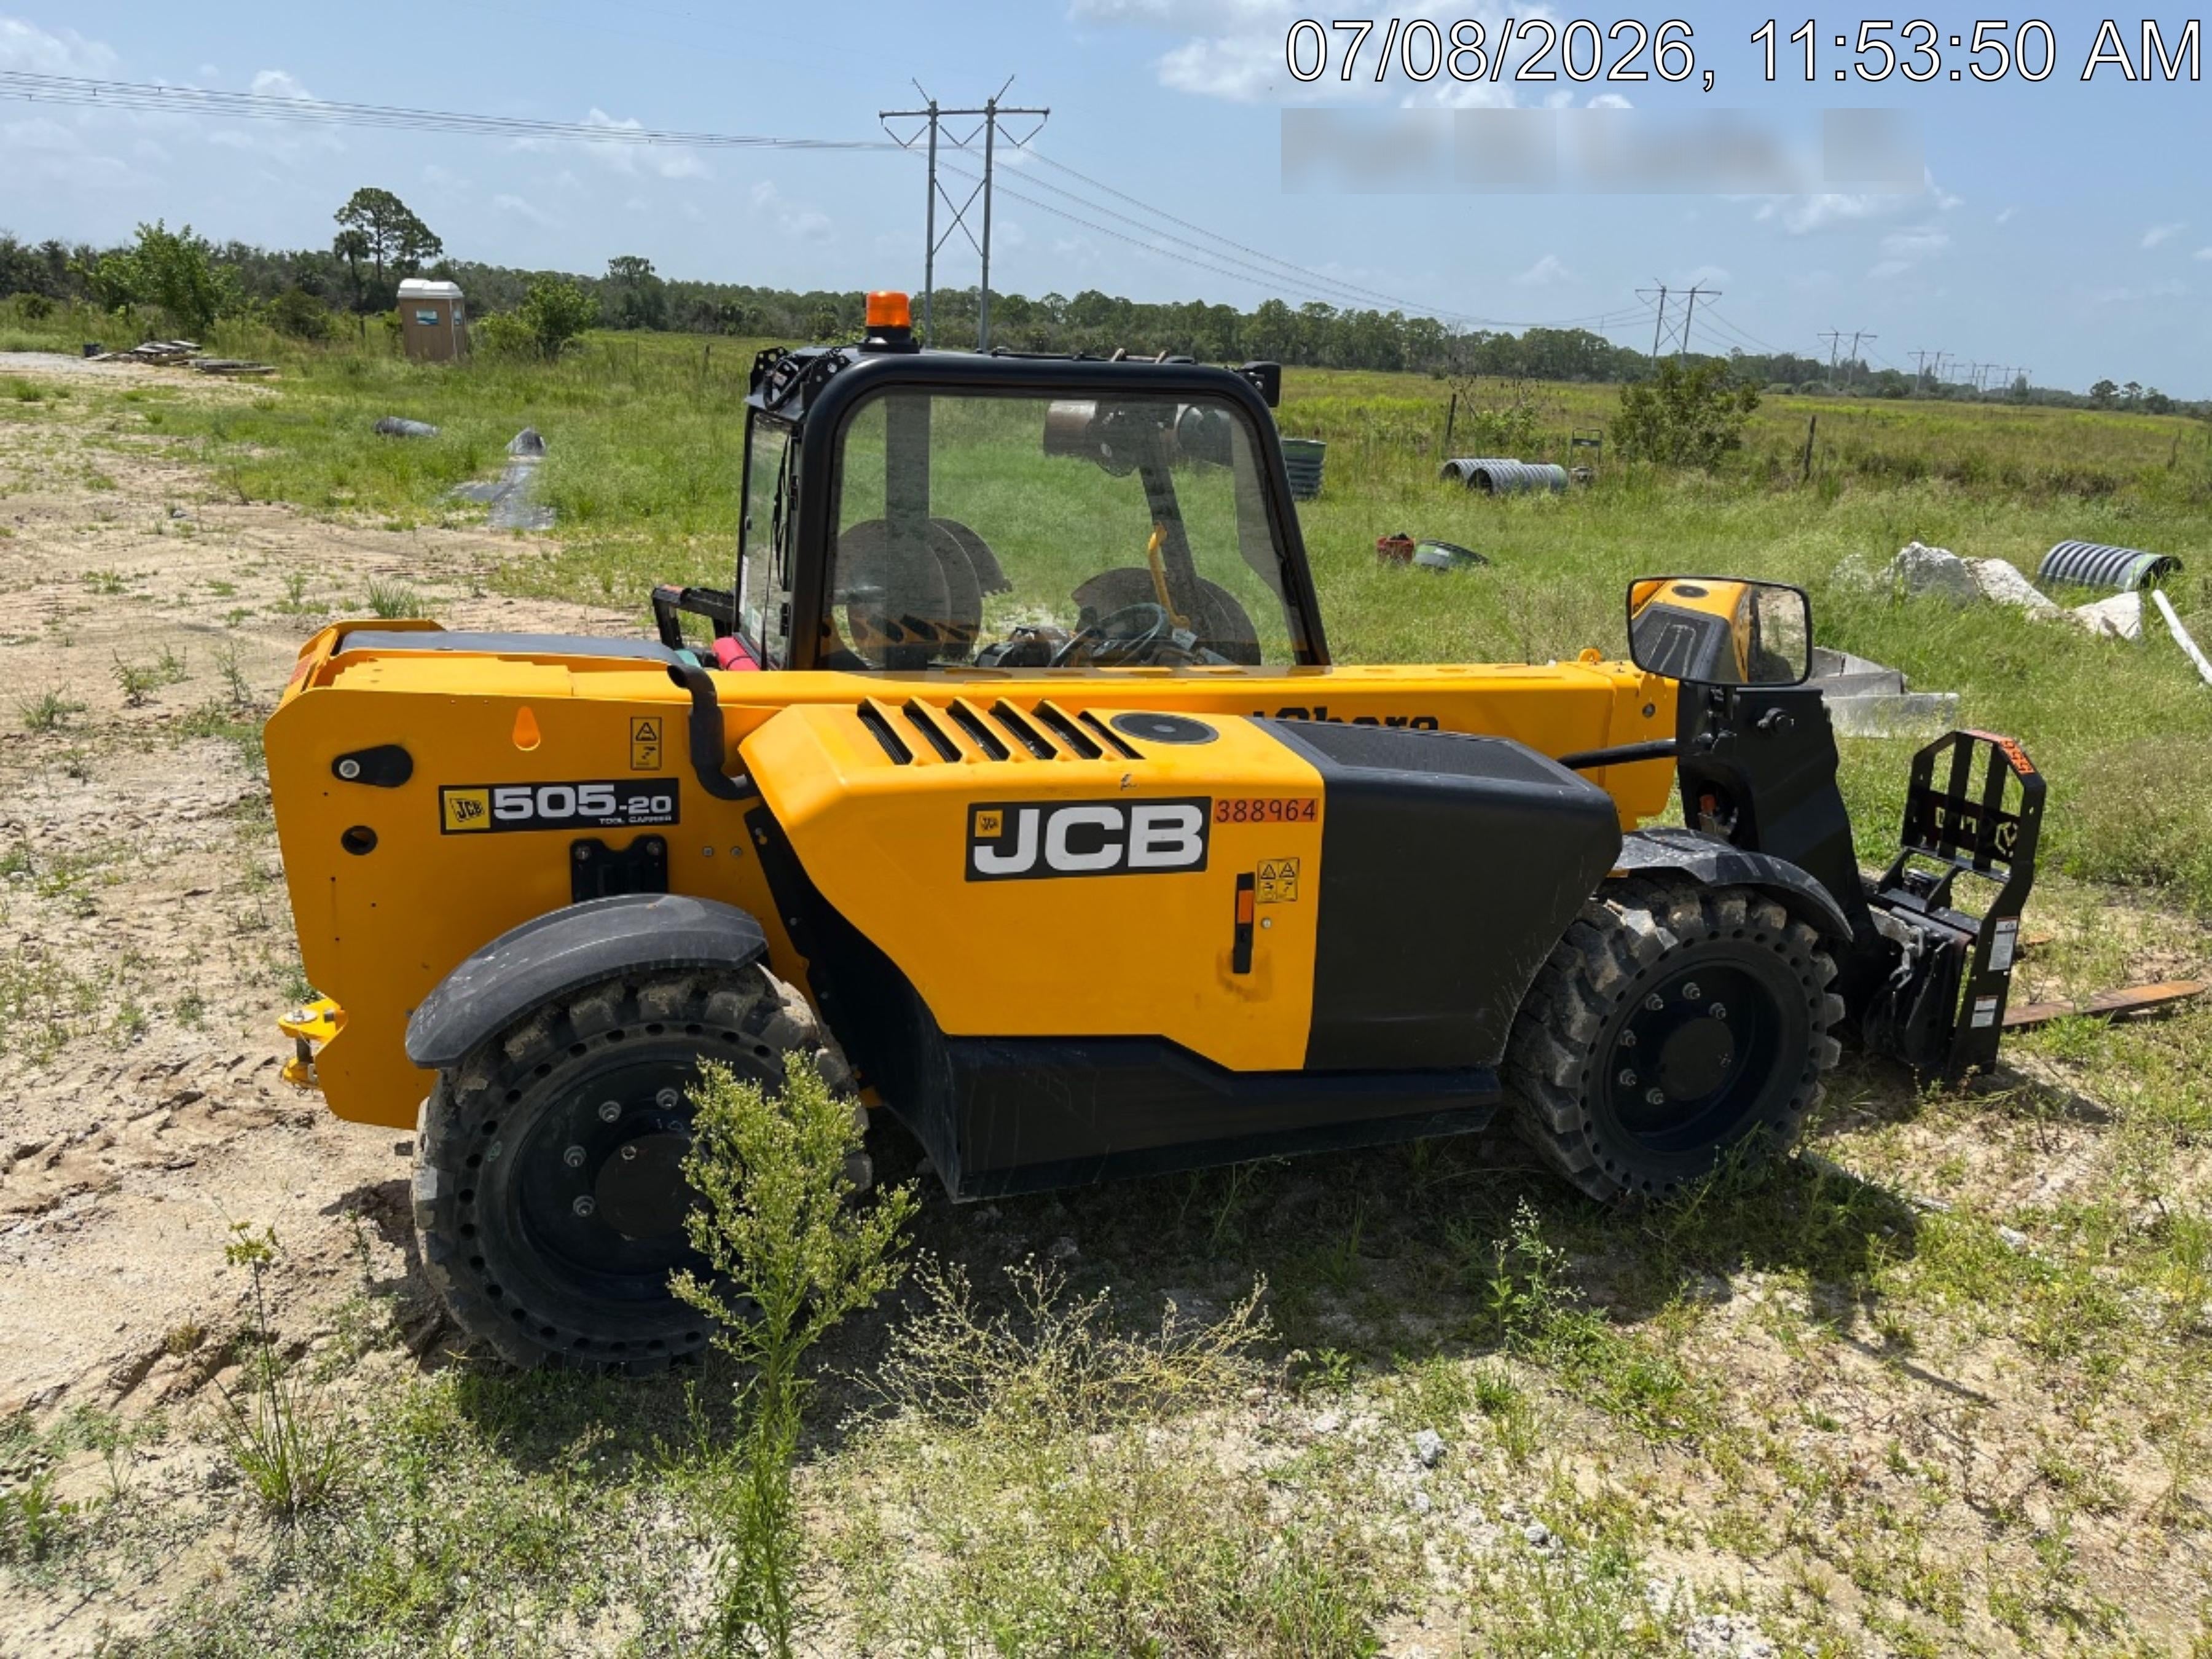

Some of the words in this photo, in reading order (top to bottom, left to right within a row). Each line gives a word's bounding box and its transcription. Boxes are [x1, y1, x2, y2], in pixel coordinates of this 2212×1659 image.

[457, 801, 485, 822] JCB
[493, 784, 672, 819] 505-20
[1215, 799, 1317, 822] 388964
[973, 805, 1203, 874] JCB
